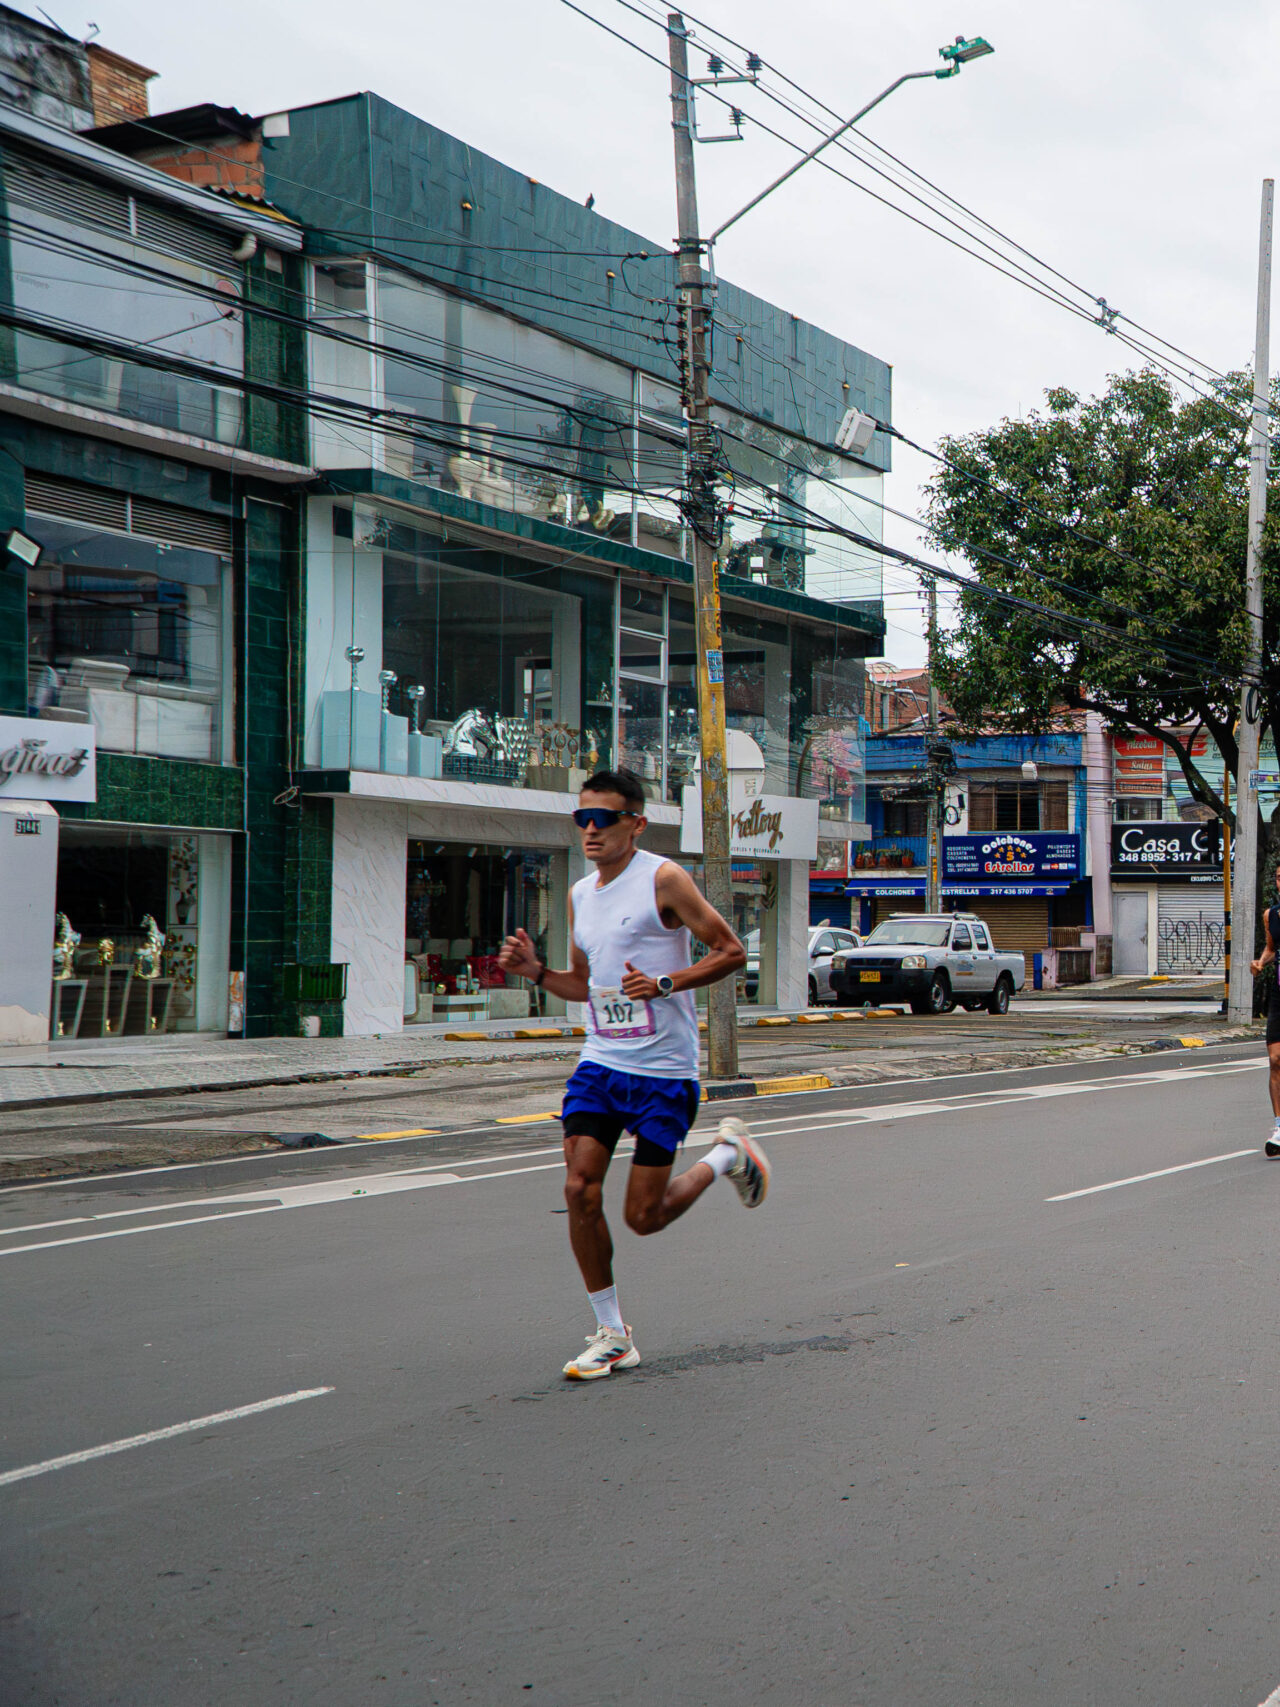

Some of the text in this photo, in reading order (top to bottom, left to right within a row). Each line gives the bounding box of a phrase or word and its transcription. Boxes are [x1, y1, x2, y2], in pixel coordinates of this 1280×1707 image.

[981, 835, 1037, 855] Colchones
[1120, 828, 1180, 853] Casa
[1006, 851, 1014, 861] 5
[1119, 853, 1139, 862] 348
[1141, 853, 1166, 862] 8952
[1172, 853, 1192, 862] 317
[984, 861, 1035, 873] Estrellas
[941, 888, 979, 896] ESTRELLAS
[603, 1002, 633, 1024] 107
